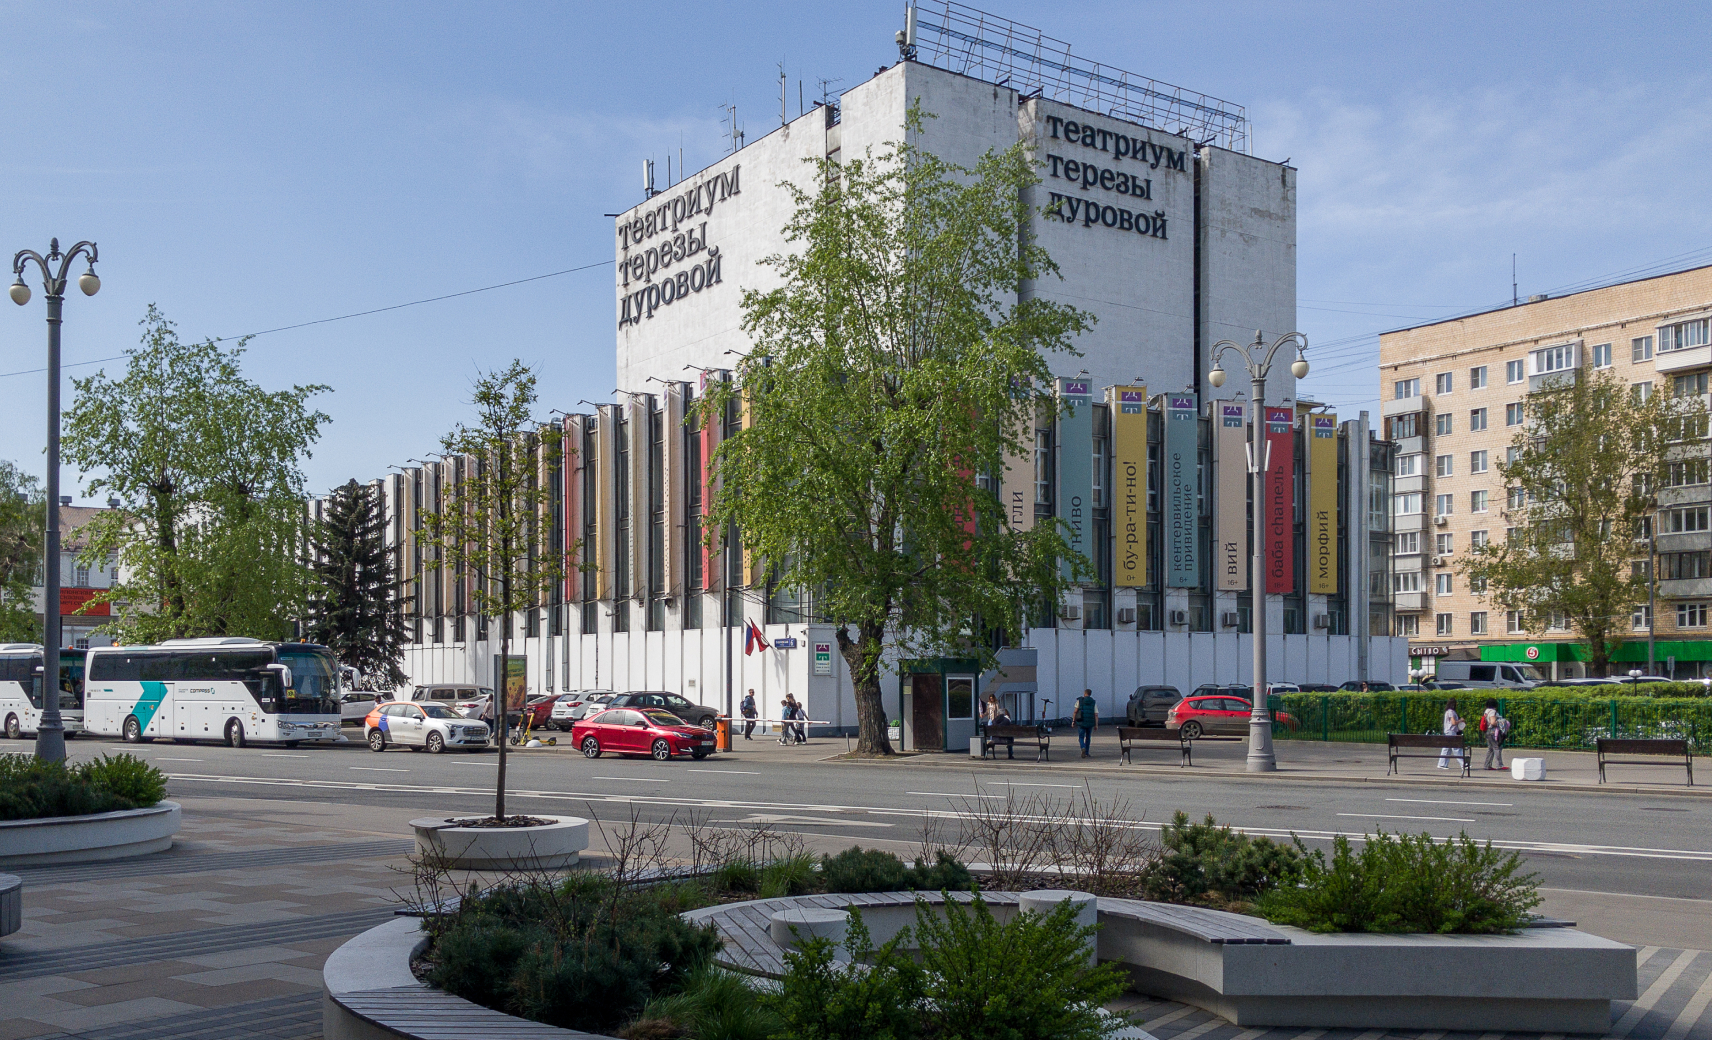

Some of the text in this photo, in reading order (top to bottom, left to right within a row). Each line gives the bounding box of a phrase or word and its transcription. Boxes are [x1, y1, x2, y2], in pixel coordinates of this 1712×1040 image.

[1046, 114, 1187, 172] театриум
[618, 163, 741, 250] театриум
[1046, 153, 1153, 201] терезы
[1049, 191, 1169, 240] дуровой
[618, 221, 708, 286] терезы
[618, 245, 723, 331] дуровой
[1012, 490, 1024, 553] угли
[1071, 496, 1082, 557] гниво
[1123, 460, 1139, 570] бу-ра-ти-но!
[1173, 452, 1183, 571] кентервильское
[1184, 483, 1195, 571] привидение
[1224, 541, 1237, 575] вий
[1271, 539, 1284, 579] баба
[1316, 510, 1330, 579] морфий
